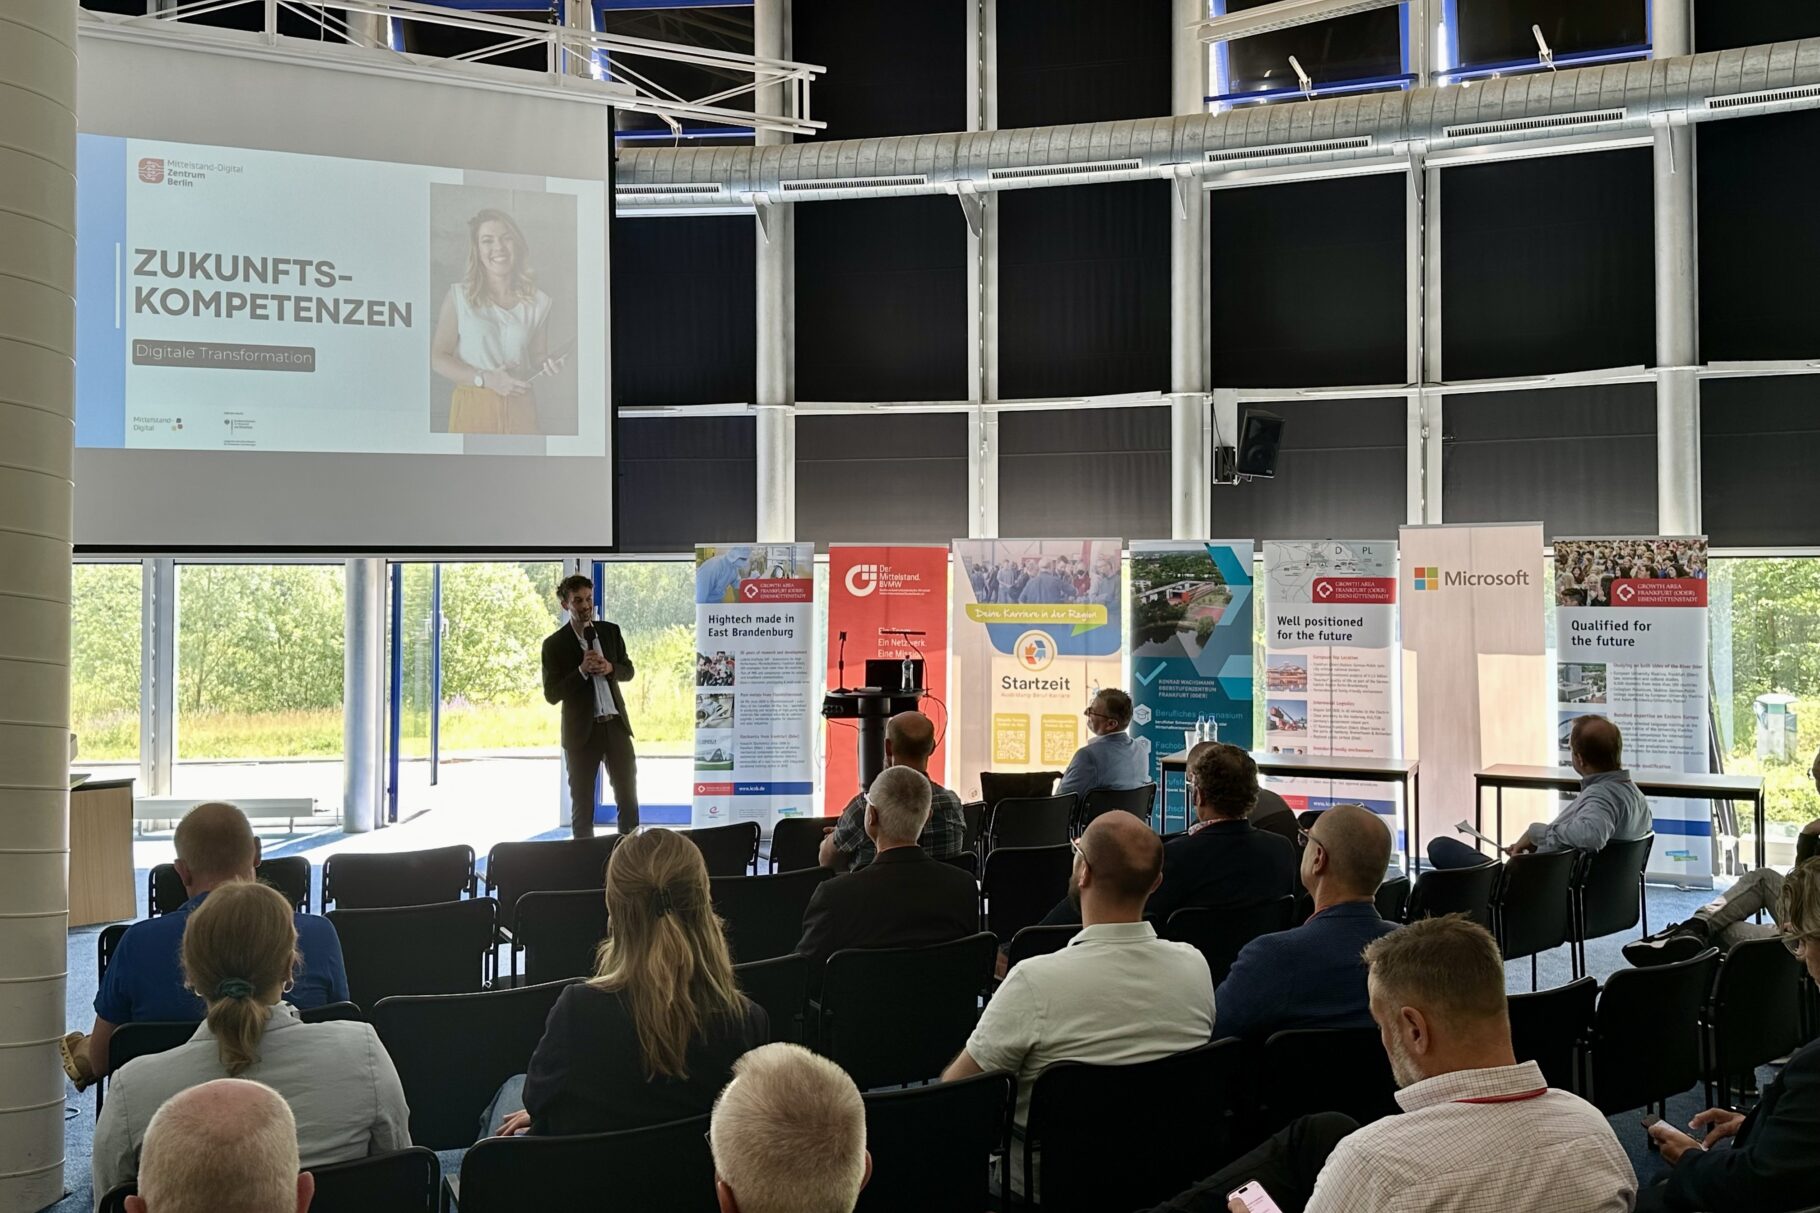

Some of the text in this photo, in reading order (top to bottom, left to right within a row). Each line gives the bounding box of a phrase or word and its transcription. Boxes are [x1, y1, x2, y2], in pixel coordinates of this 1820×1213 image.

[167, 160, 243, 174] Mittelstand-Digital
[167, 169, 206, 179] Zentrum
[167, 178, 194, 187] Berlin
[133, 248, 353, 288] ZUKUNFTS-
[134, 286, 413, 328] KOMPETENZEN
[136, 343, 312, 364] Digitale Transformation
[1335, 546, 1373, 554] D PL
[1444, 570, 1530, 586] Microsoft
[708, 614, 794, 626] Hightech made in
[974, 608, 1097, 622] Deine Karriere in der Region
[1277, 616, 1363, 628] Well positioned
[1572, 620, 1652, 632] Qualified for
[708, 628, 794, 638] East Brandenburg
[1277, 630, 1352, 640] for the future
[878, 638, 890, 646] Ein
[1572, 636, 1635, 646] the future
[878, 650, 894, 658] Eine
[1002, 676, 1070, 690] Startzeit
[1155, 710, 1196, 718] Berufliches
